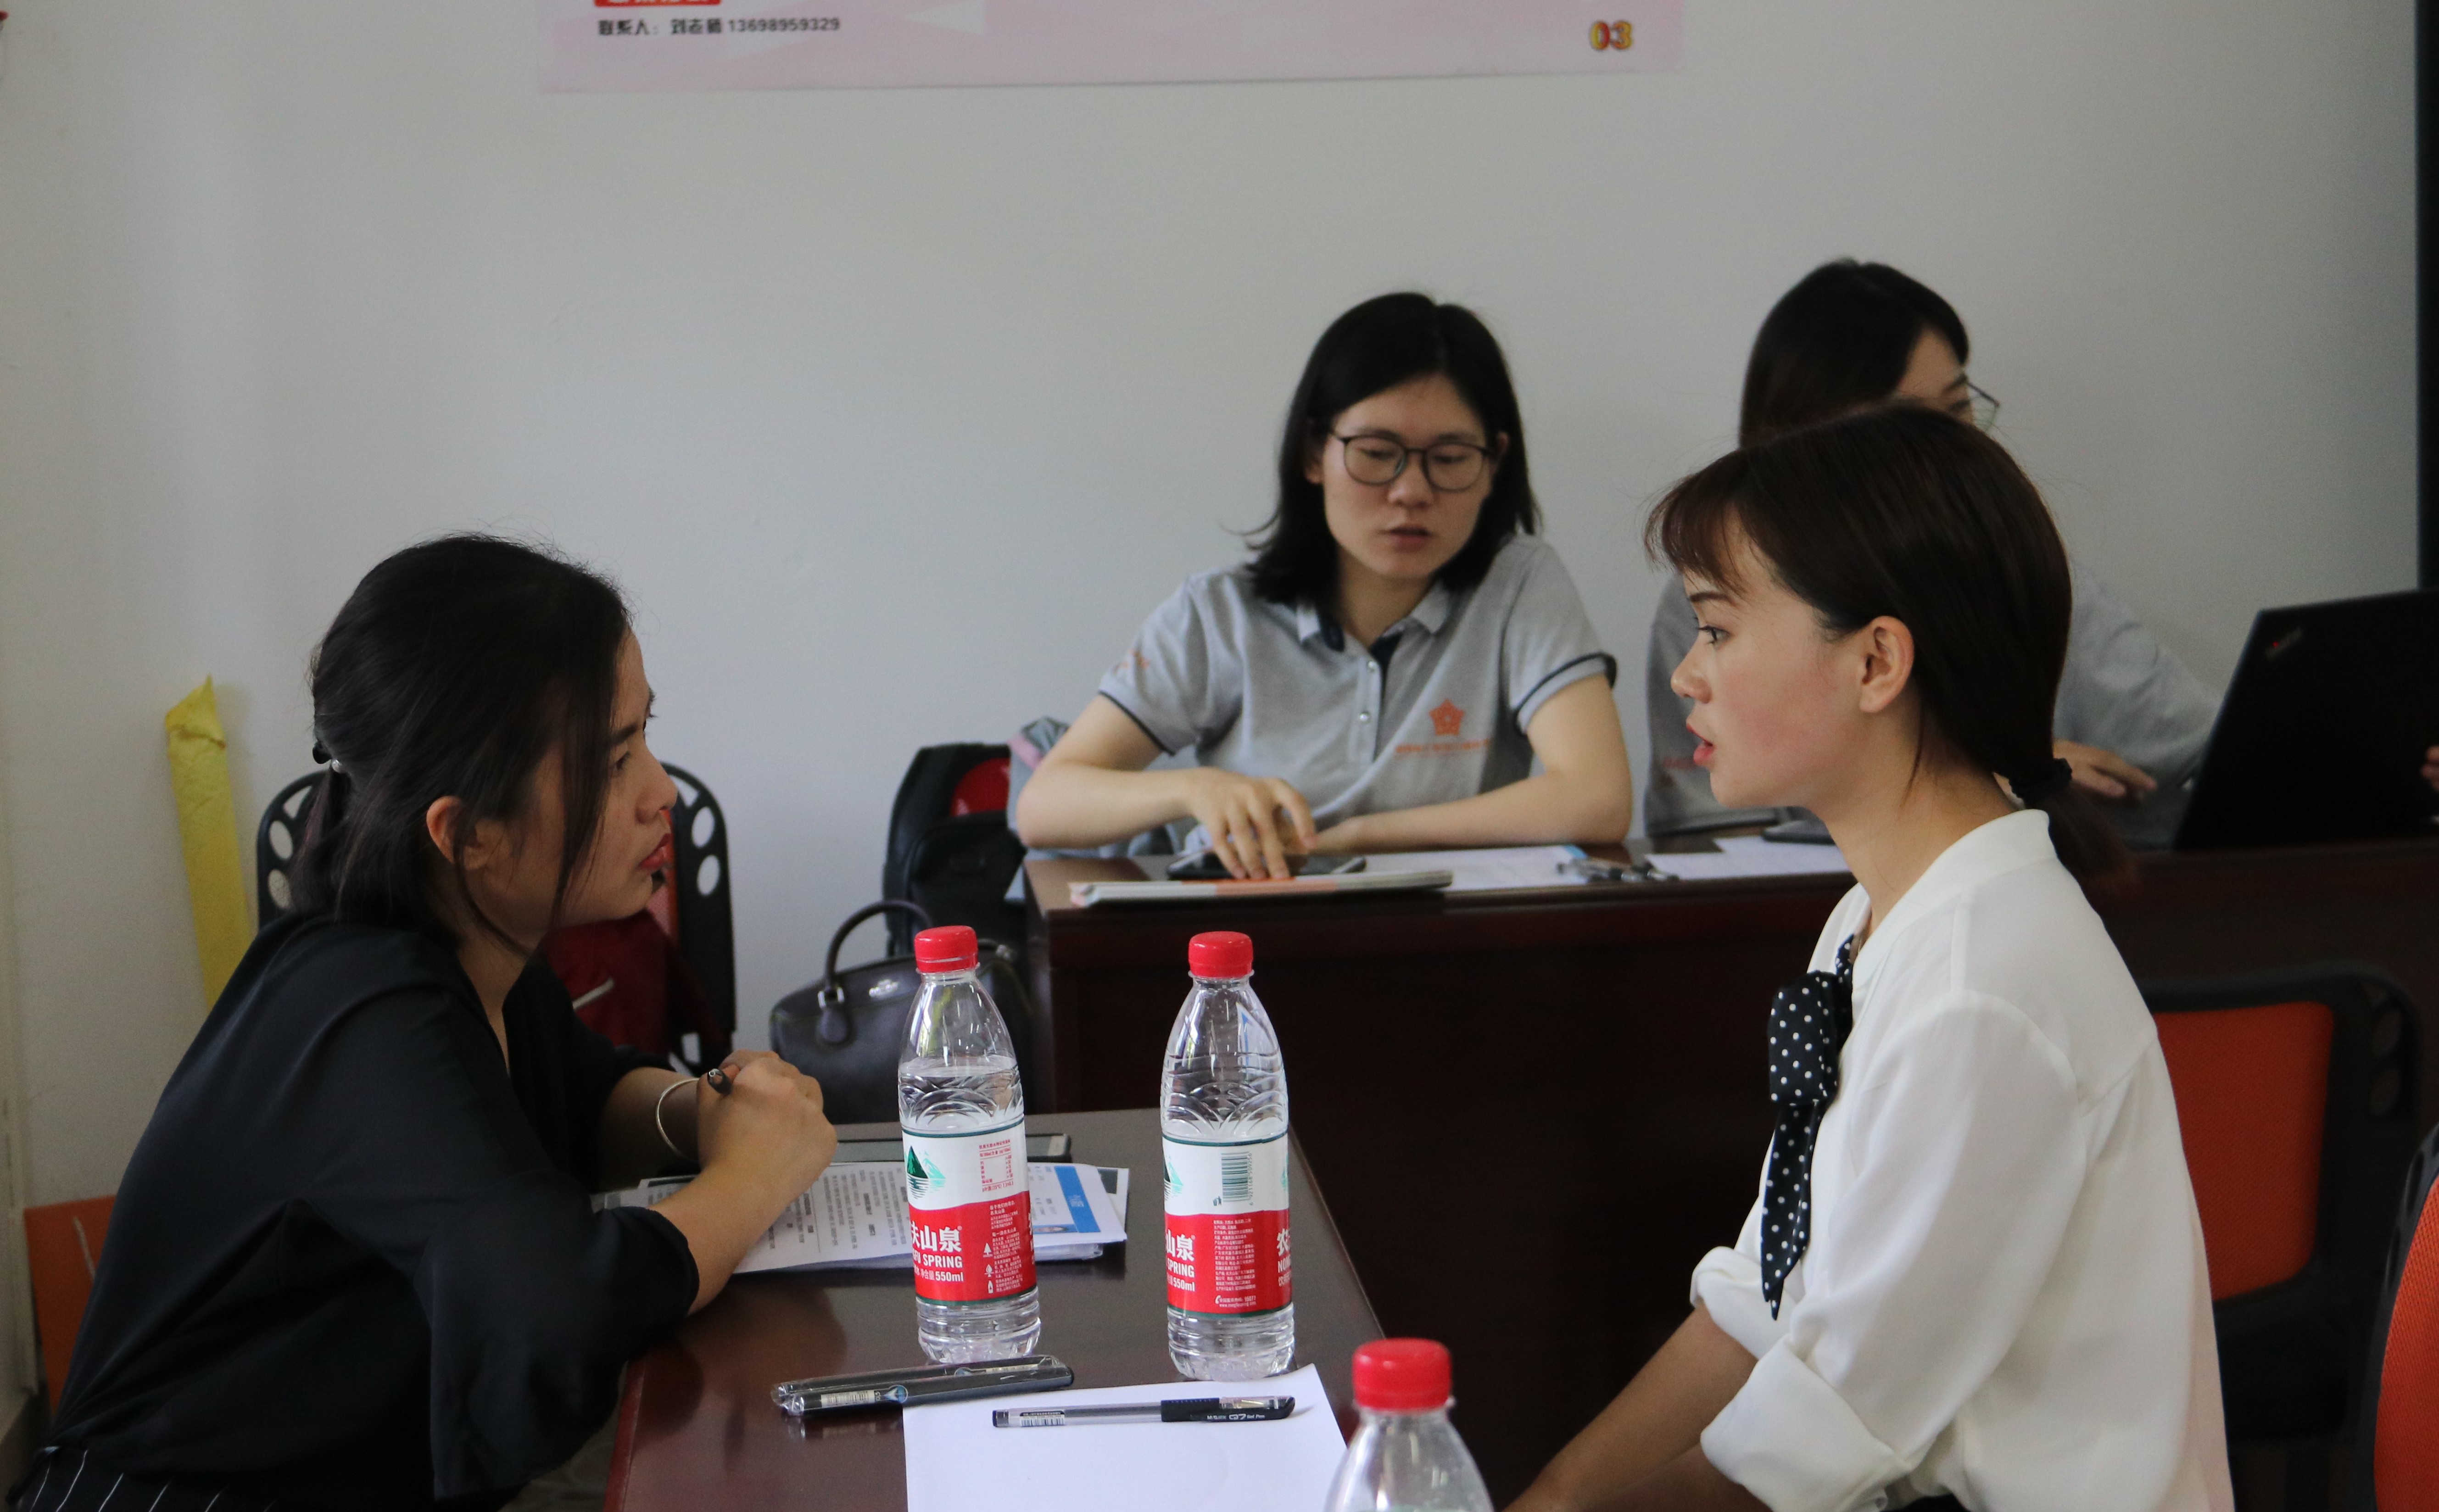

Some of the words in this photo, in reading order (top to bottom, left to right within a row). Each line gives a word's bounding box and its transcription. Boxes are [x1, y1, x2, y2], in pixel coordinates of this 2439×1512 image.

[1589, 20, 1633, 50] 03
[923, 1253, 963, 1268] SPRING
[1167, 1257, 1194, 1278] SPRING
